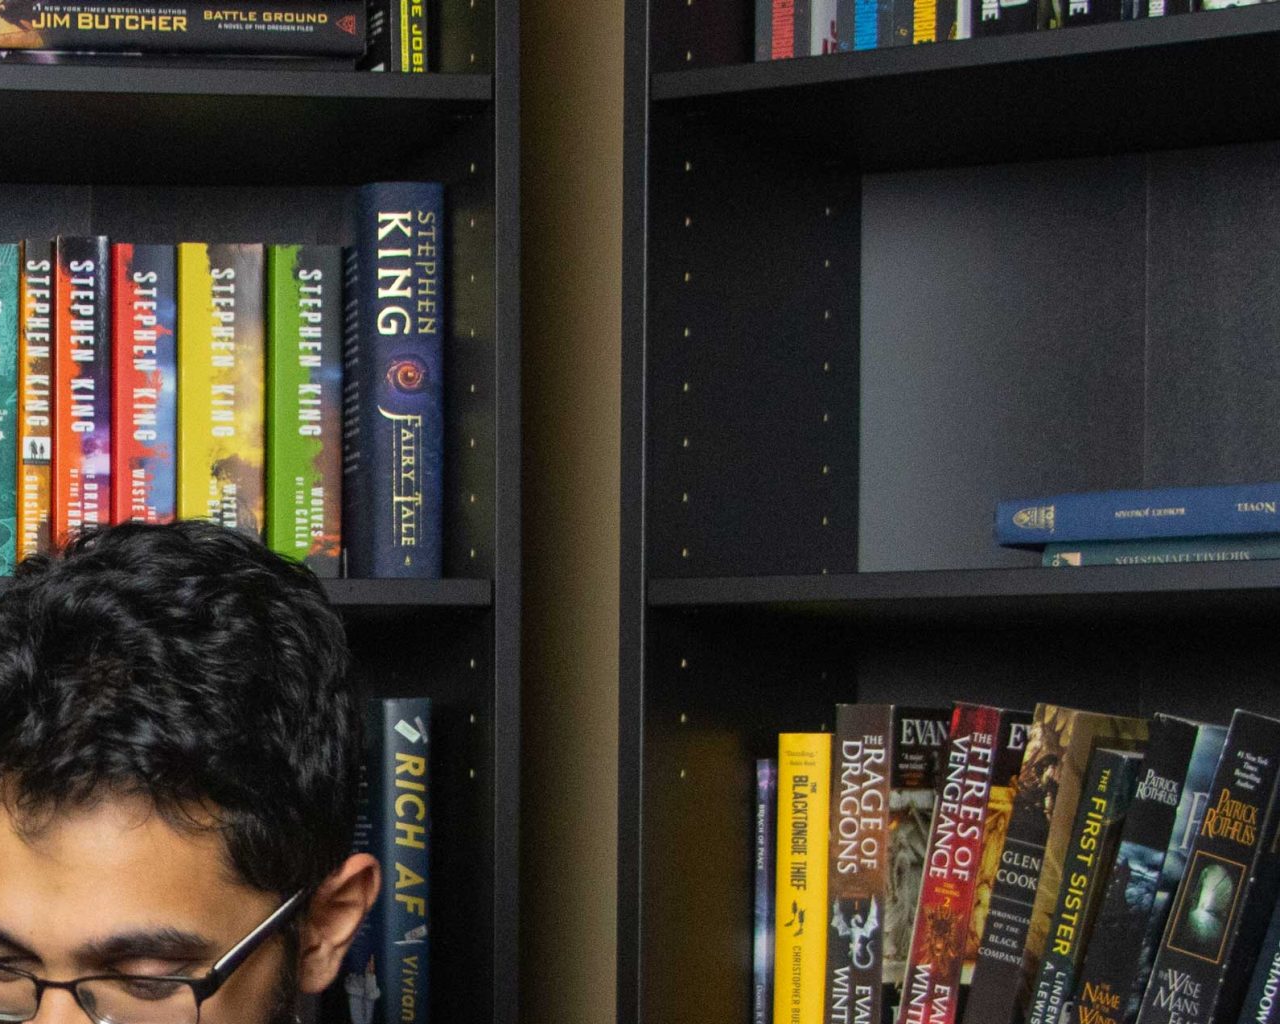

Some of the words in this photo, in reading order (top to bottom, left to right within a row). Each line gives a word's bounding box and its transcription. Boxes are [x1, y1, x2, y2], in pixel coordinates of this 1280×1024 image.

[31, 12, 72, 29] JIM
[78, 14, 187, 32] BUTCHER
[203, 10, 256, 22] BATTLE
[263, 11, 328, 24] GROUND
[377, 211, 412, 336] KING
[417, 211, 436, 335] STEPHEN
[26, 260, 50, 358] STEPHEN
[70, 260, 95, 362] STEPHEN
[133, 272, 157, 372] STEPHEN
[25, 374, 49, 427] KING
[71, 379, 95, 433] KING
[133, 388, 157, 441] KING
[377, 404, 421, 491] FAIRY
[394, 491, 422, 547] TALE
[394, 752, 426, 849] RICH
[791, 775, 808, 855] BLACKTONGUE
[837, 740, 862, 875] DRAGONS
[861, 749, 885, 831] RAGE
[929, 736, 970, 878] VENGEANCE
[957, 745, 992, 840] FIRES
[860, 837, 878, 870] OF
[952, 846, 972, 882] OF
[1003, 850, 1041, 871] GLEN
[1077, 796, 1107, 867] FIRST
[394, 862, 426, 917] AF
[790, 856, 807, 891] THIEF
[996, 869, 1038, 890] COOK
[1051, 872, 1088, 956] SISTER
[793, 946, 801, 1006] CHRISTOPHER
